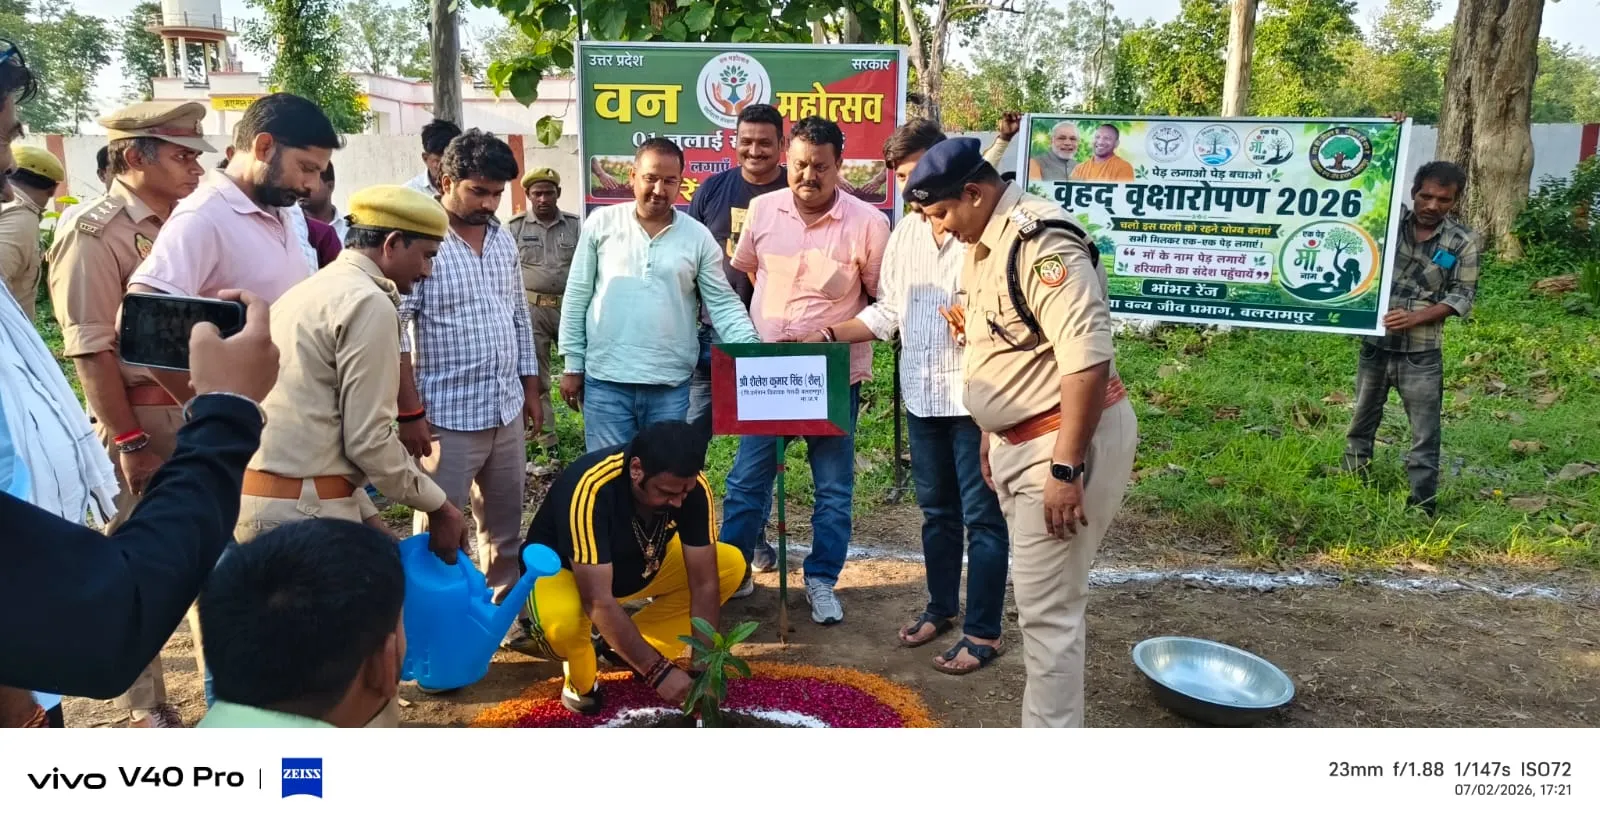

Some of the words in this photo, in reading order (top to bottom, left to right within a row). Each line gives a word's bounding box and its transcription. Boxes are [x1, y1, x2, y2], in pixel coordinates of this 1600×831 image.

[589, 53, 613, 67] उत्तर
[616, 51, 644, 67] प्रदेश
[851, 58, 890, 71] सरकार
[593, 83, 683, 124] वन
[776, 81, 885, 124] महोत्सव
[1152, 166, 1168, 178] पेड़
[1171, 166, 1206, 178] लगाओ
[1210, 167, 1226, 179] पेड़
[1229, 168, 1262, 179] बचाओ
[1053, 180, 1117, 214] वृहद्
[1125, 180, 1271, 216] वृक्षारोपण
[1276, 188, 1362, 218] 2026
[1120, 219, 1139, 230] चलो
[1142, 221, 1157, 231] इस
[1160, 220, 1182, 232] धरती
[1185, 222, 1197, 232] को
[1199, 223, 1217, 233] रहने
[1221, 224, 1244, 234] योग्य
[1129, 234, 1147, 243] सभी
[1150, 235, 1180, 245] मिलकर
[1182, 238, 1216, 246] एक-एक
[1219, 238, 1231, 249] पेड़
[1159, 250, 1170, 260] के
[1173, 253, 1193, 262] नाम
[1198, 252, 1212, 264] पेड़
[1217, 253, 1247, 265] लगायें
[1134, 262, 1172, 275] हरियाली
[1175, 266, 1189, 276] का
[1193, 264, 1217, 277] संदेश
[1151, 281, 1192, 295] भांभर
[1195, 284, 1218, 298] रेंज
[1125, 301, 1152, 311] वन्य
[1157, 300, 1184, 313] जीव
[1190, 305, 1235, 317] प्रभाग,
[1240, 307, 1315, 324] बलरामपुर
[740, 374, 748, 387] श्री
[749, 374, 768, 387] शैलेश
[769, 376, 788, 388] कुमार
[790, 373, 803, 386] सिंह
